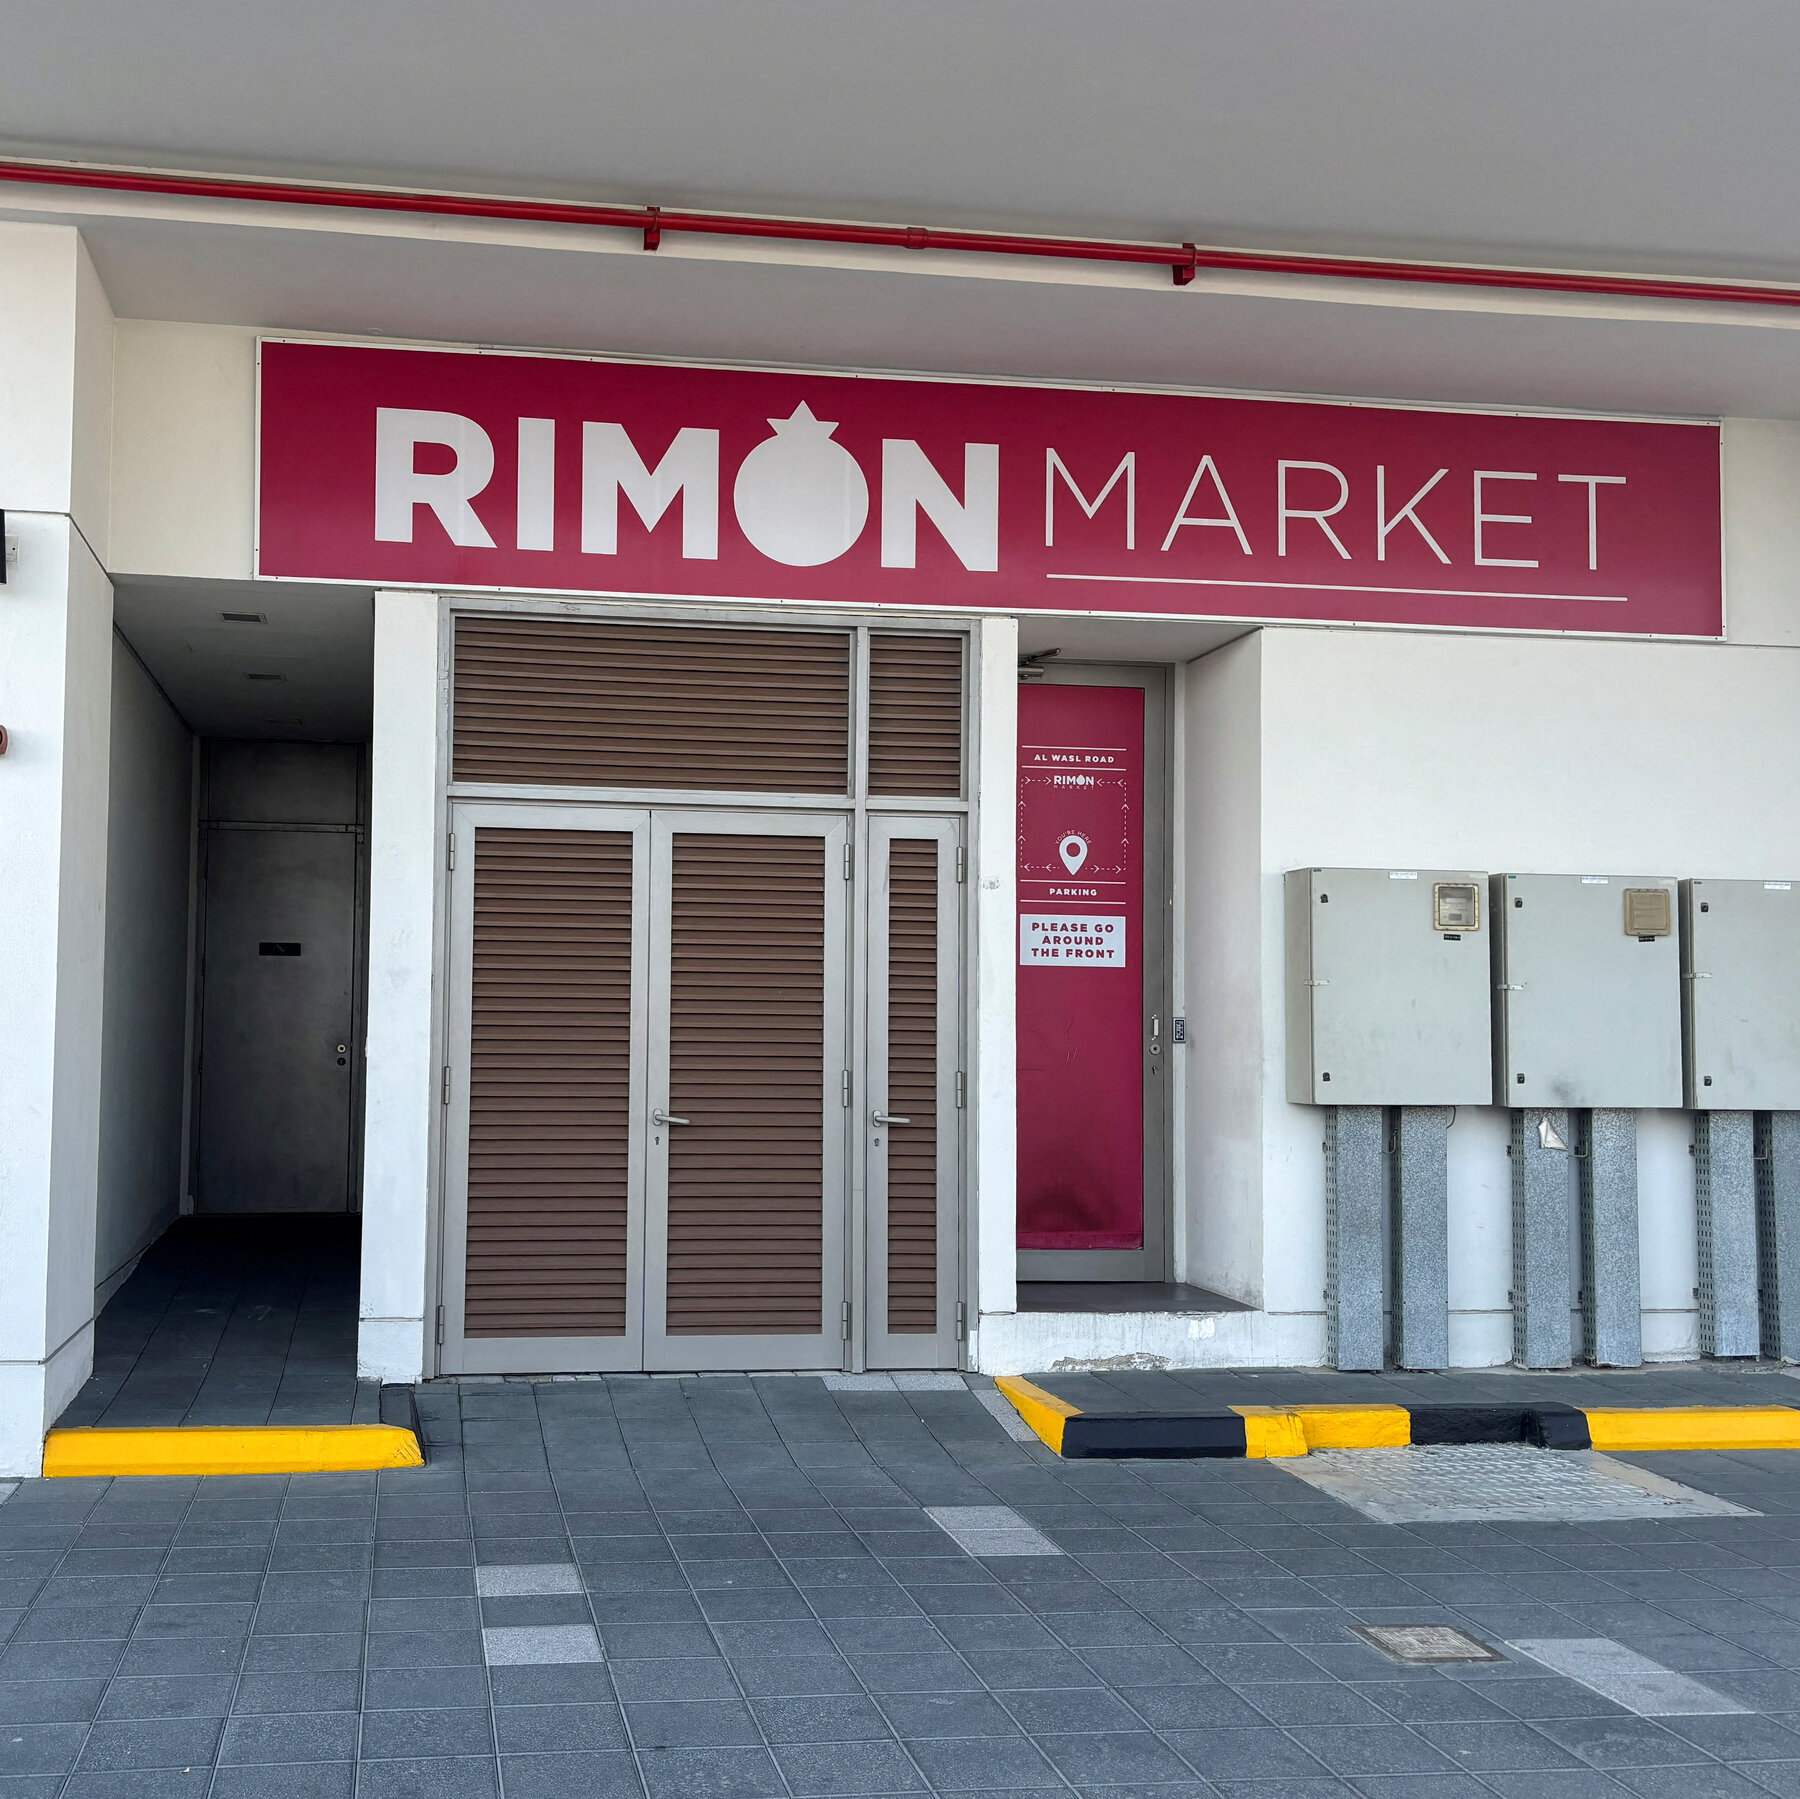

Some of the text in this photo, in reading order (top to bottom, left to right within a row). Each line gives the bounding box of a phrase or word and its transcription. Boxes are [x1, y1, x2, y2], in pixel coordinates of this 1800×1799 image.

[375, 400, 1627, 572] RIMON MARKET
[1051, 754, 1082, 762] WASL
[1084, 755, 1115, 763] ROAD
[1053, 774, 1095, 786] RIMON
[1055, 829, 1092, 844] YOU'RE HERE
[1049, 888, 1098, 897] PARKING
[1031, 922, 1115, 934] PLEASE GO
[1042, 935, 1105, 946] AROUND
[1031, 947, 1115, 959] THE FRONT
